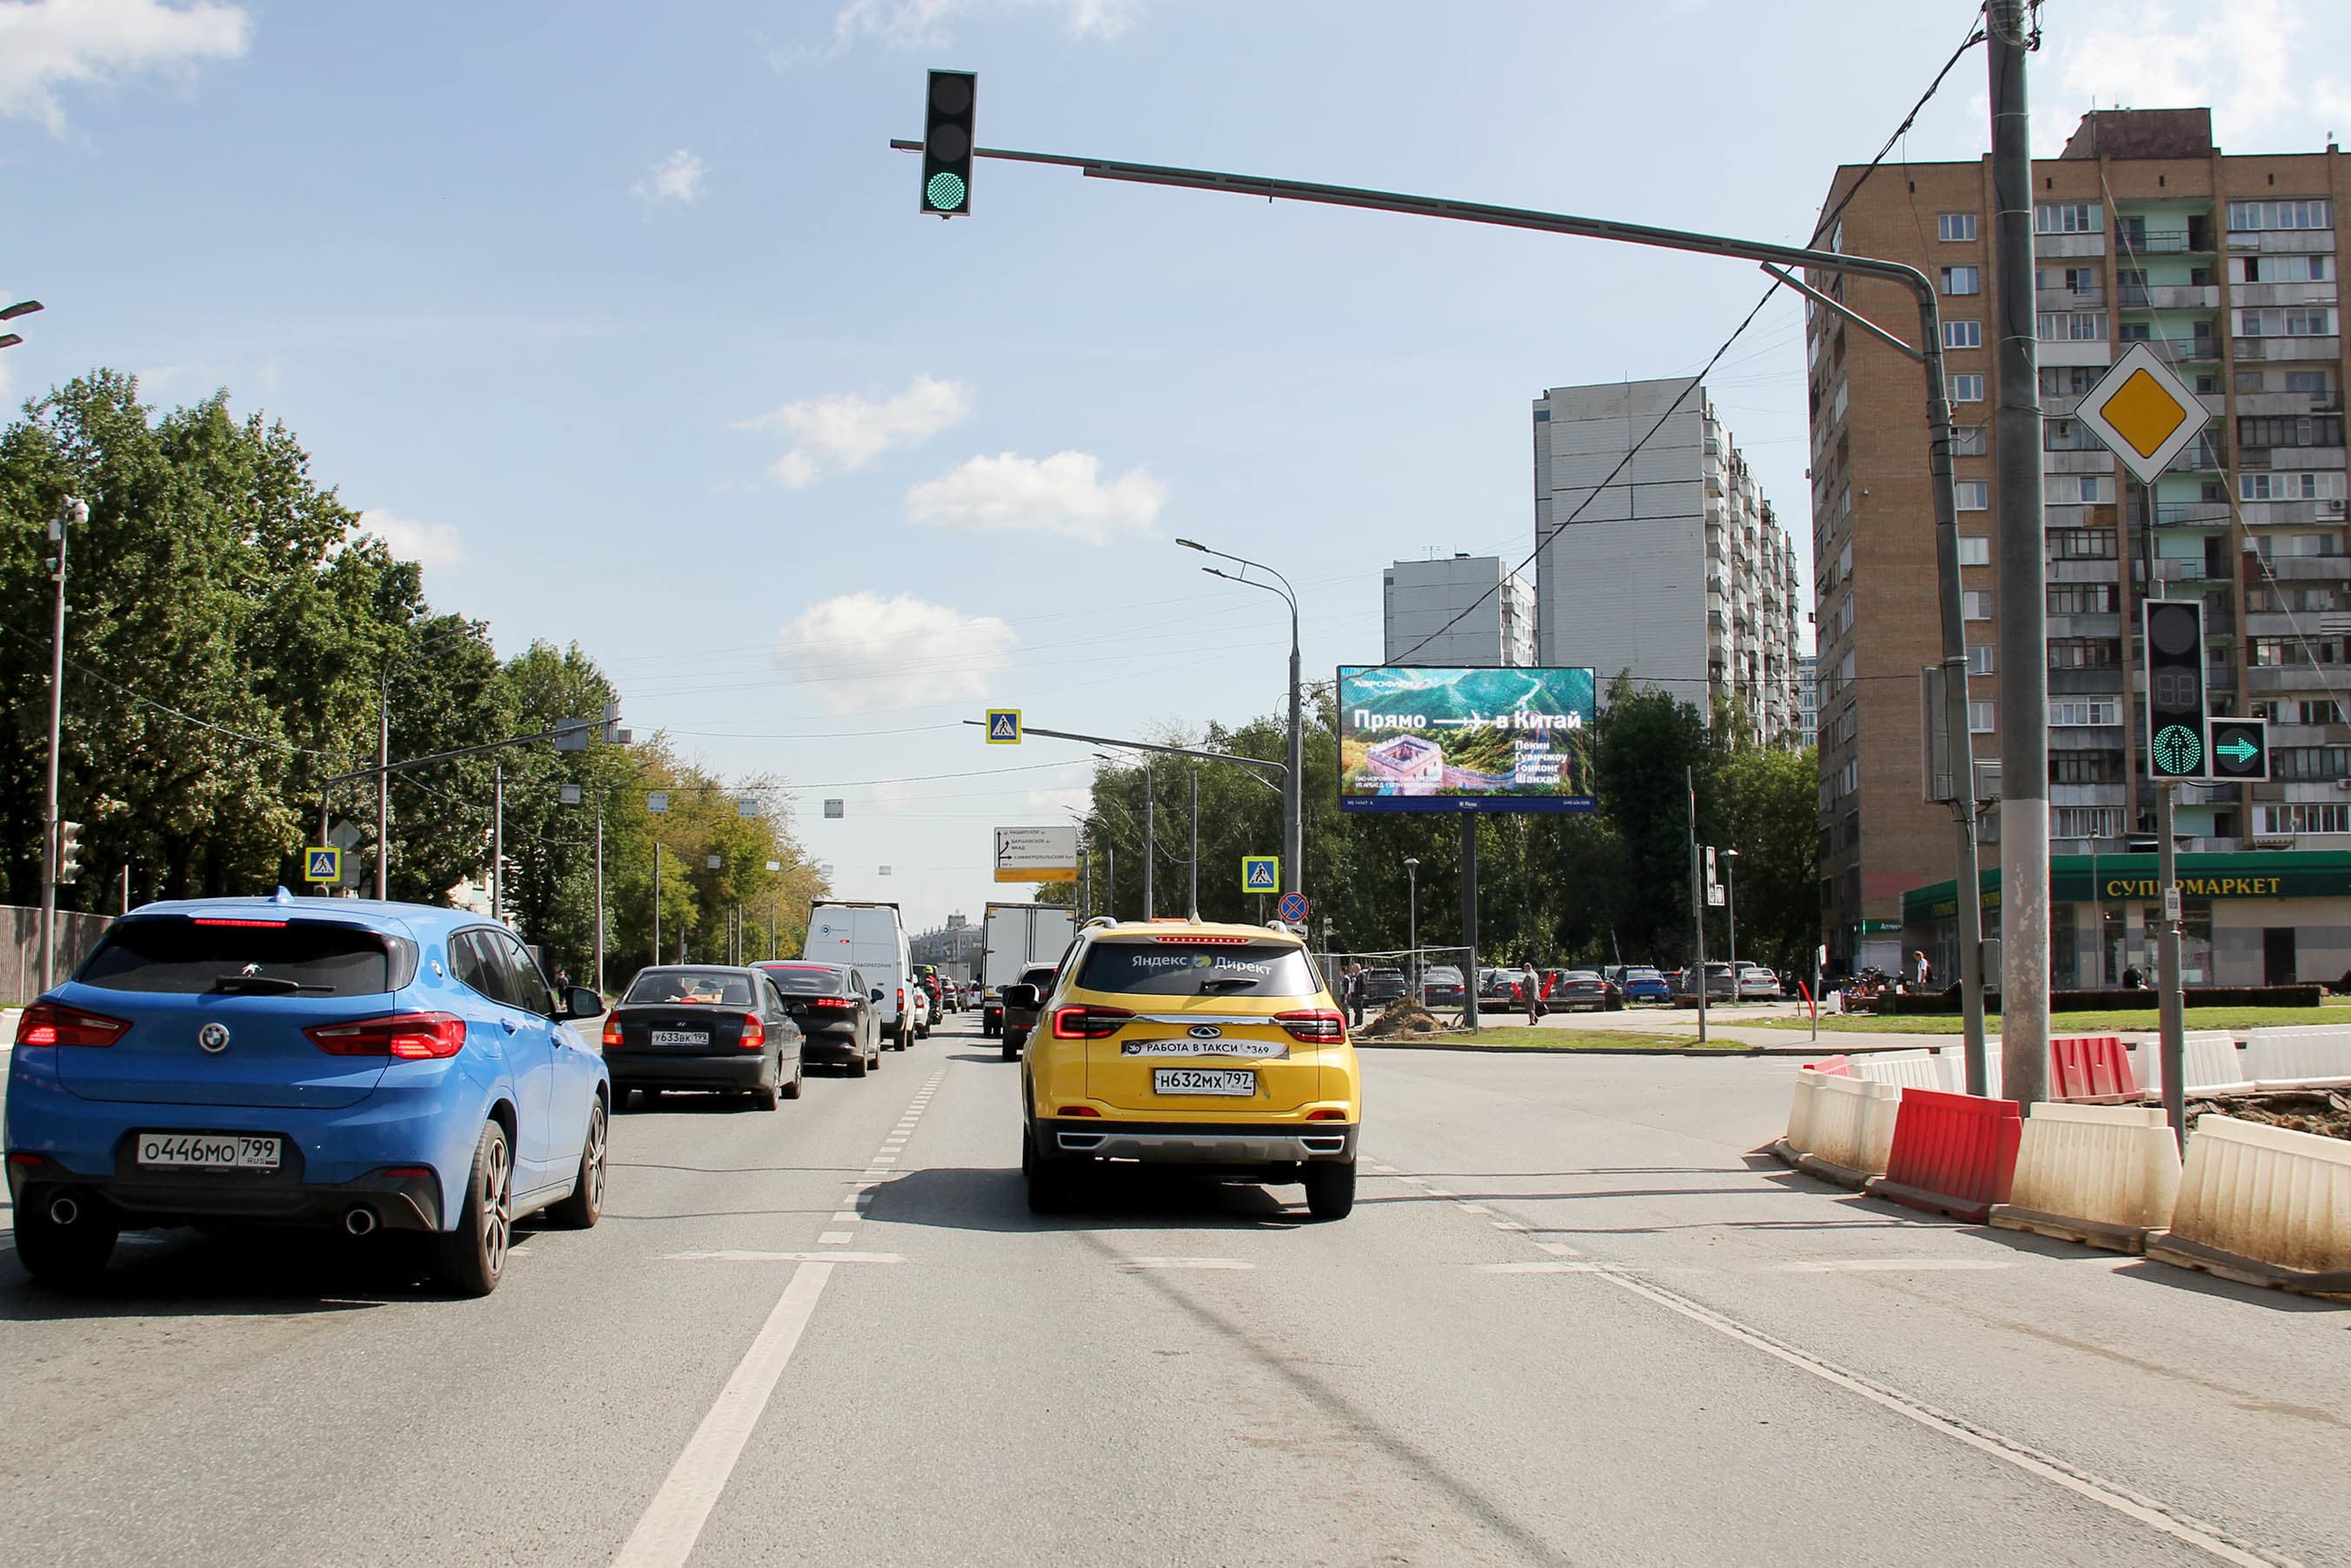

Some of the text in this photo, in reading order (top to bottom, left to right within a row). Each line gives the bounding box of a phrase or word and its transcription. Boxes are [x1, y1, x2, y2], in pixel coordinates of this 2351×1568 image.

[1354, 709, 1582, 732] Прямо в Китай
[1515, 740, 1550, 751] Пекин
[1515, 751, 1567, 764] Гуанчжоу
[1515, 763, 1560, 772] Гонконг
[1515, 773, 1560, 784] Шанхай
[2107, 877, 2281, 896] СУПРМАРКЕТ
[1132, 955, 1272, 975] Яндекс Директ
[1146, 1043, 1189, 1052] РАБОТА
[1204, 1043, 1238, 1052] ТАКСИ
[1160, 1072, 1249, 1089] Н632МХ 797
[241, 1138, 275, 1157] 799
